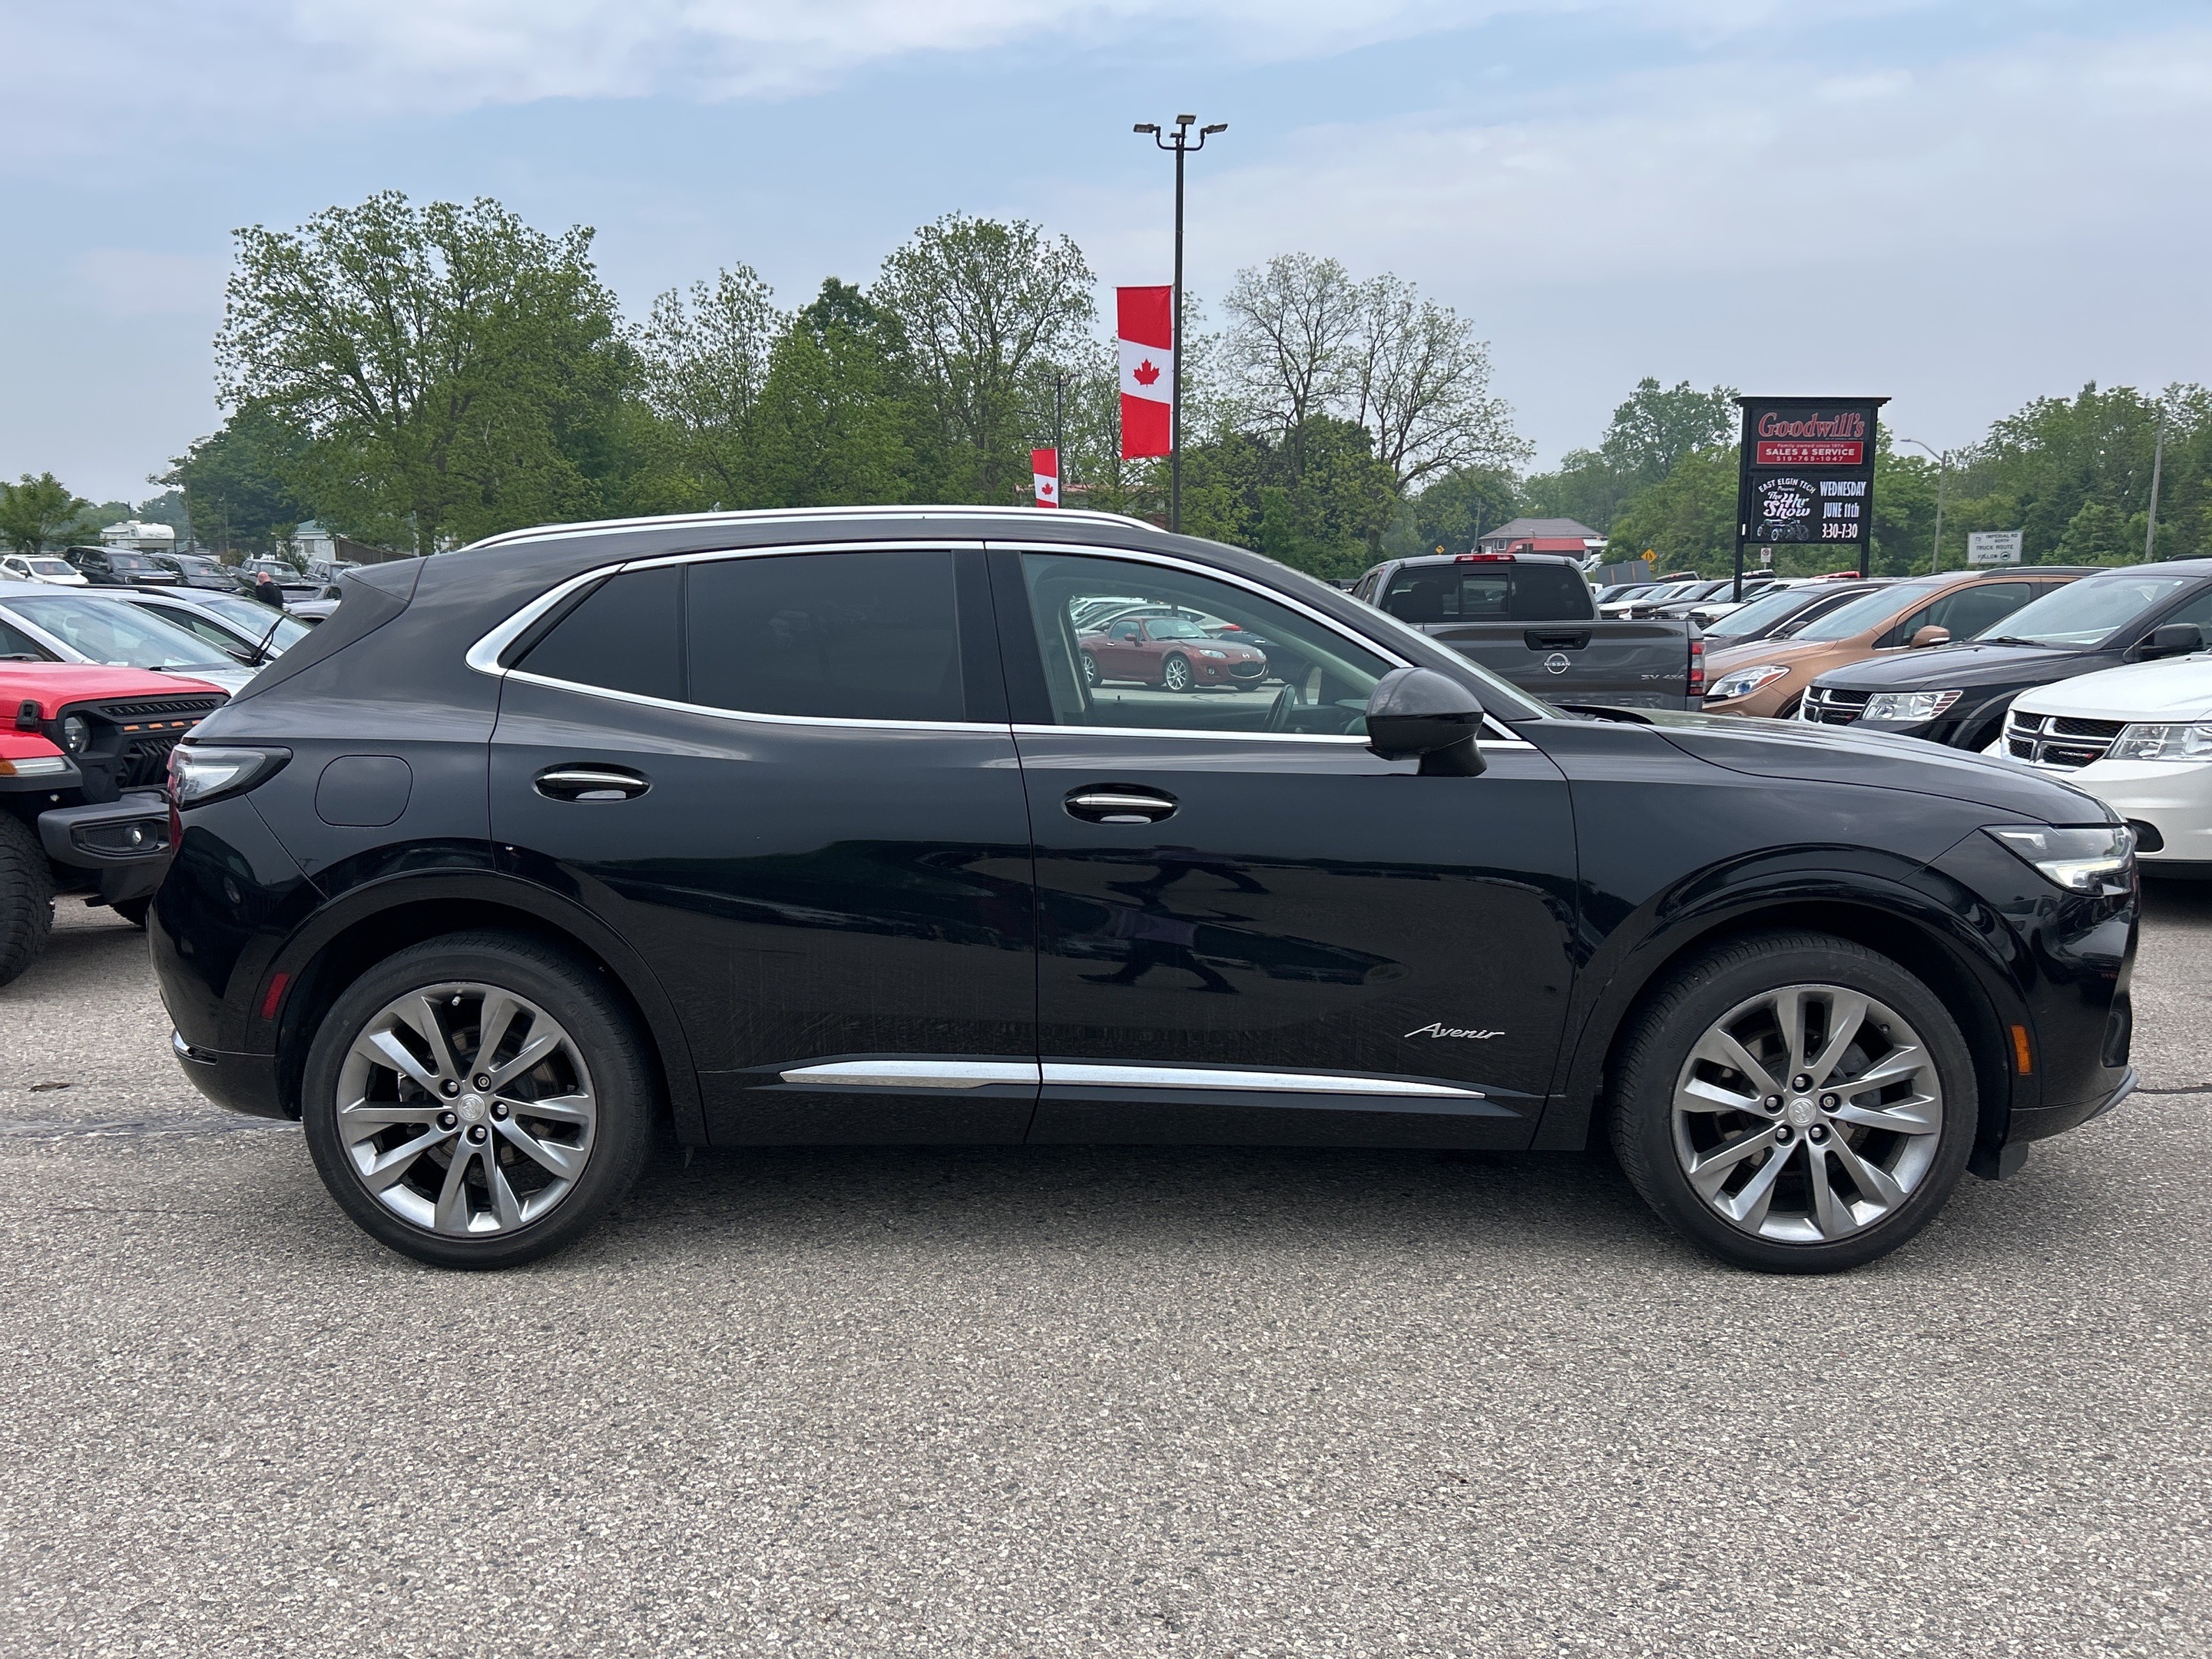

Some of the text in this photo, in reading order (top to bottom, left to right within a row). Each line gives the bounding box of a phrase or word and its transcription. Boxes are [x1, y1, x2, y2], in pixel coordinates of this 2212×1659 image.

[1758, 412, 1865, 437] Goodwill's
[1758, 478, 1816, 494] EAST ELGIN TECH
[1820, 481, 1866, 497] WEDNESDAY
[1767, 492, 1810, 508] The 4hr
[1763, 500, 1810, 519] Show
[1823, 502, 1859, 519] JUNE 11th
[1822, 523, 1858, 538] 3:30-7:30
[1404, 1022, 1505, 1039] Avenir
